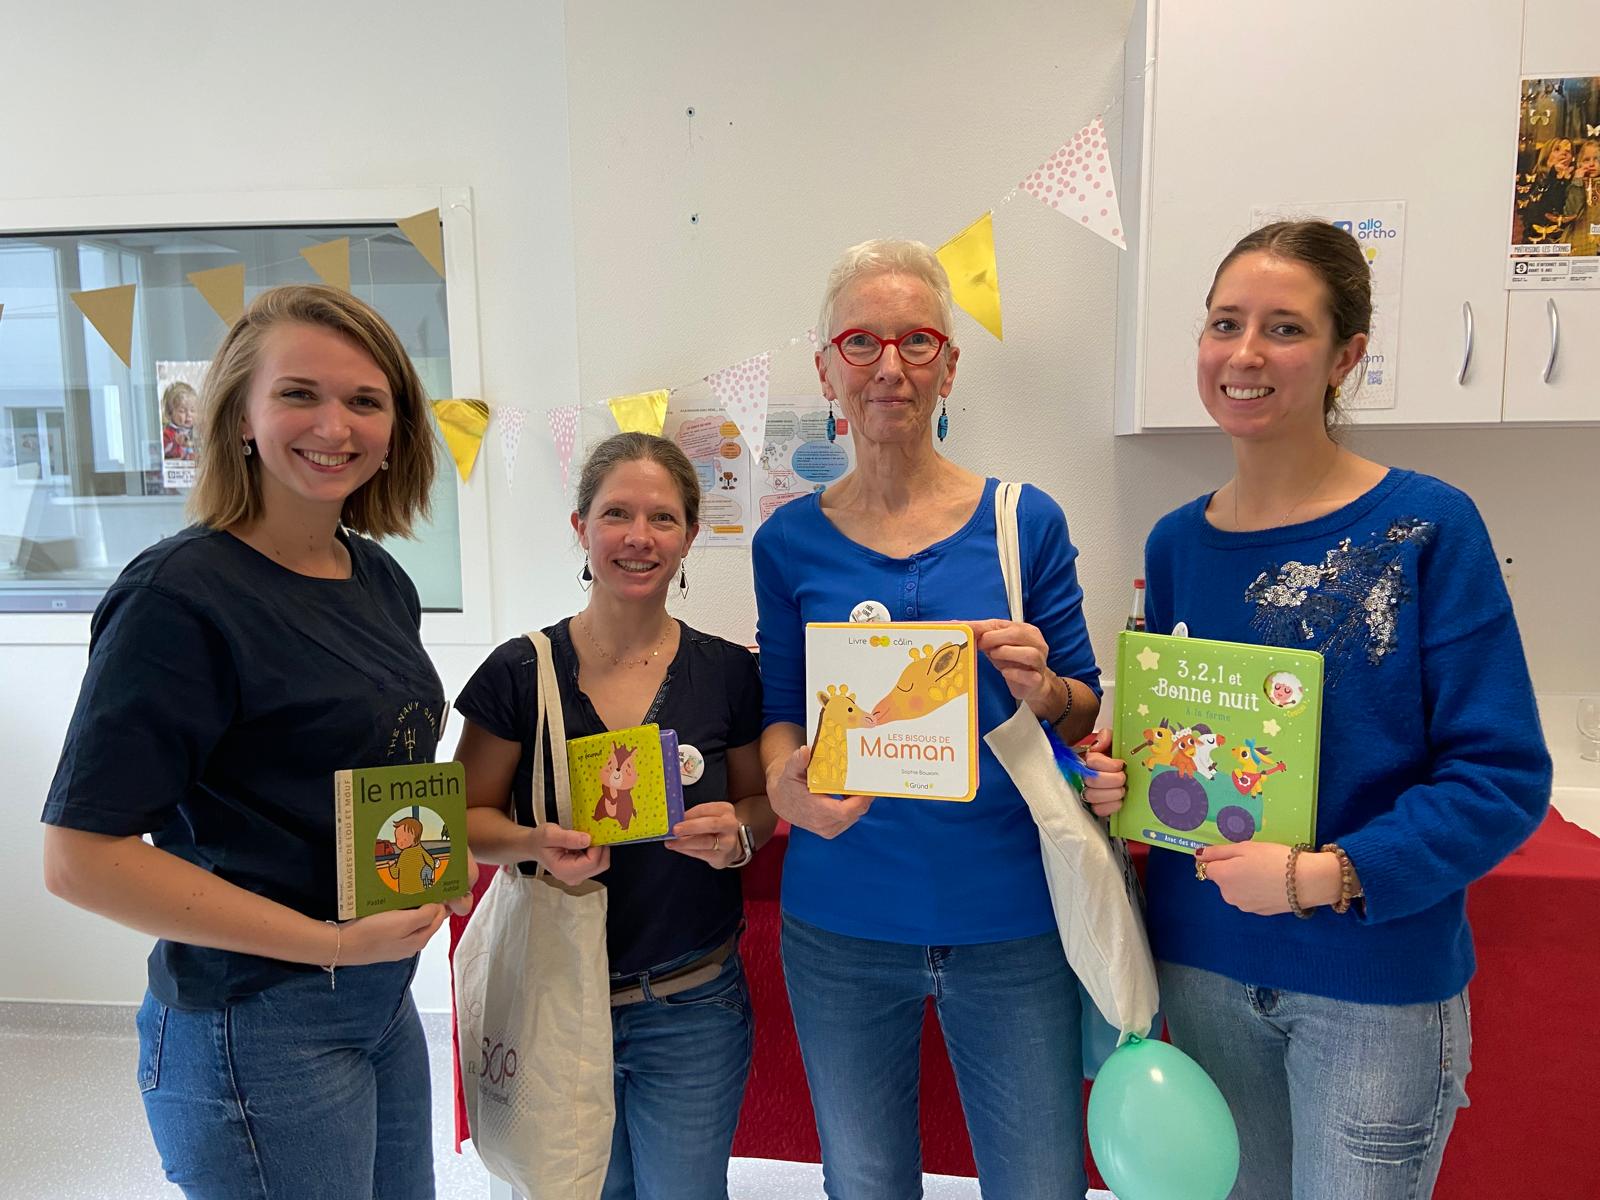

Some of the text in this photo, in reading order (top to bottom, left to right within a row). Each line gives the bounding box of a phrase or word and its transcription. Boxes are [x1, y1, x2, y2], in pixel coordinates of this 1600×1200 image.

[1358, 218, 1382, 230] allo
[1358, 228, 1396, 239] ortho
[848, 637, 913, 646] Livre câlin
[1229, 673, 1242, 686] et
[1150, 678, 1212, 704] Bonne
[1218, 689, 1260, 712] nuit
[1206, 709, 1231, 722] ferme
[386, 728, 400, 757] THE
[397, 701, 419, 723] NAVY
[888, 733, 951, 744] LES BISOUS DE
[860, 735, 955, 762] Maman
[360, 777, 382, 804] le
[390, 772, 460, 801] matin
[344, 779, 354, 912] LES IMAGES DE LOU ET MOUF
[1164, 835, 1177, 843] Avec
[1178, 838, 1189, 846] des
[366, 898, 387, 907] Pastel
